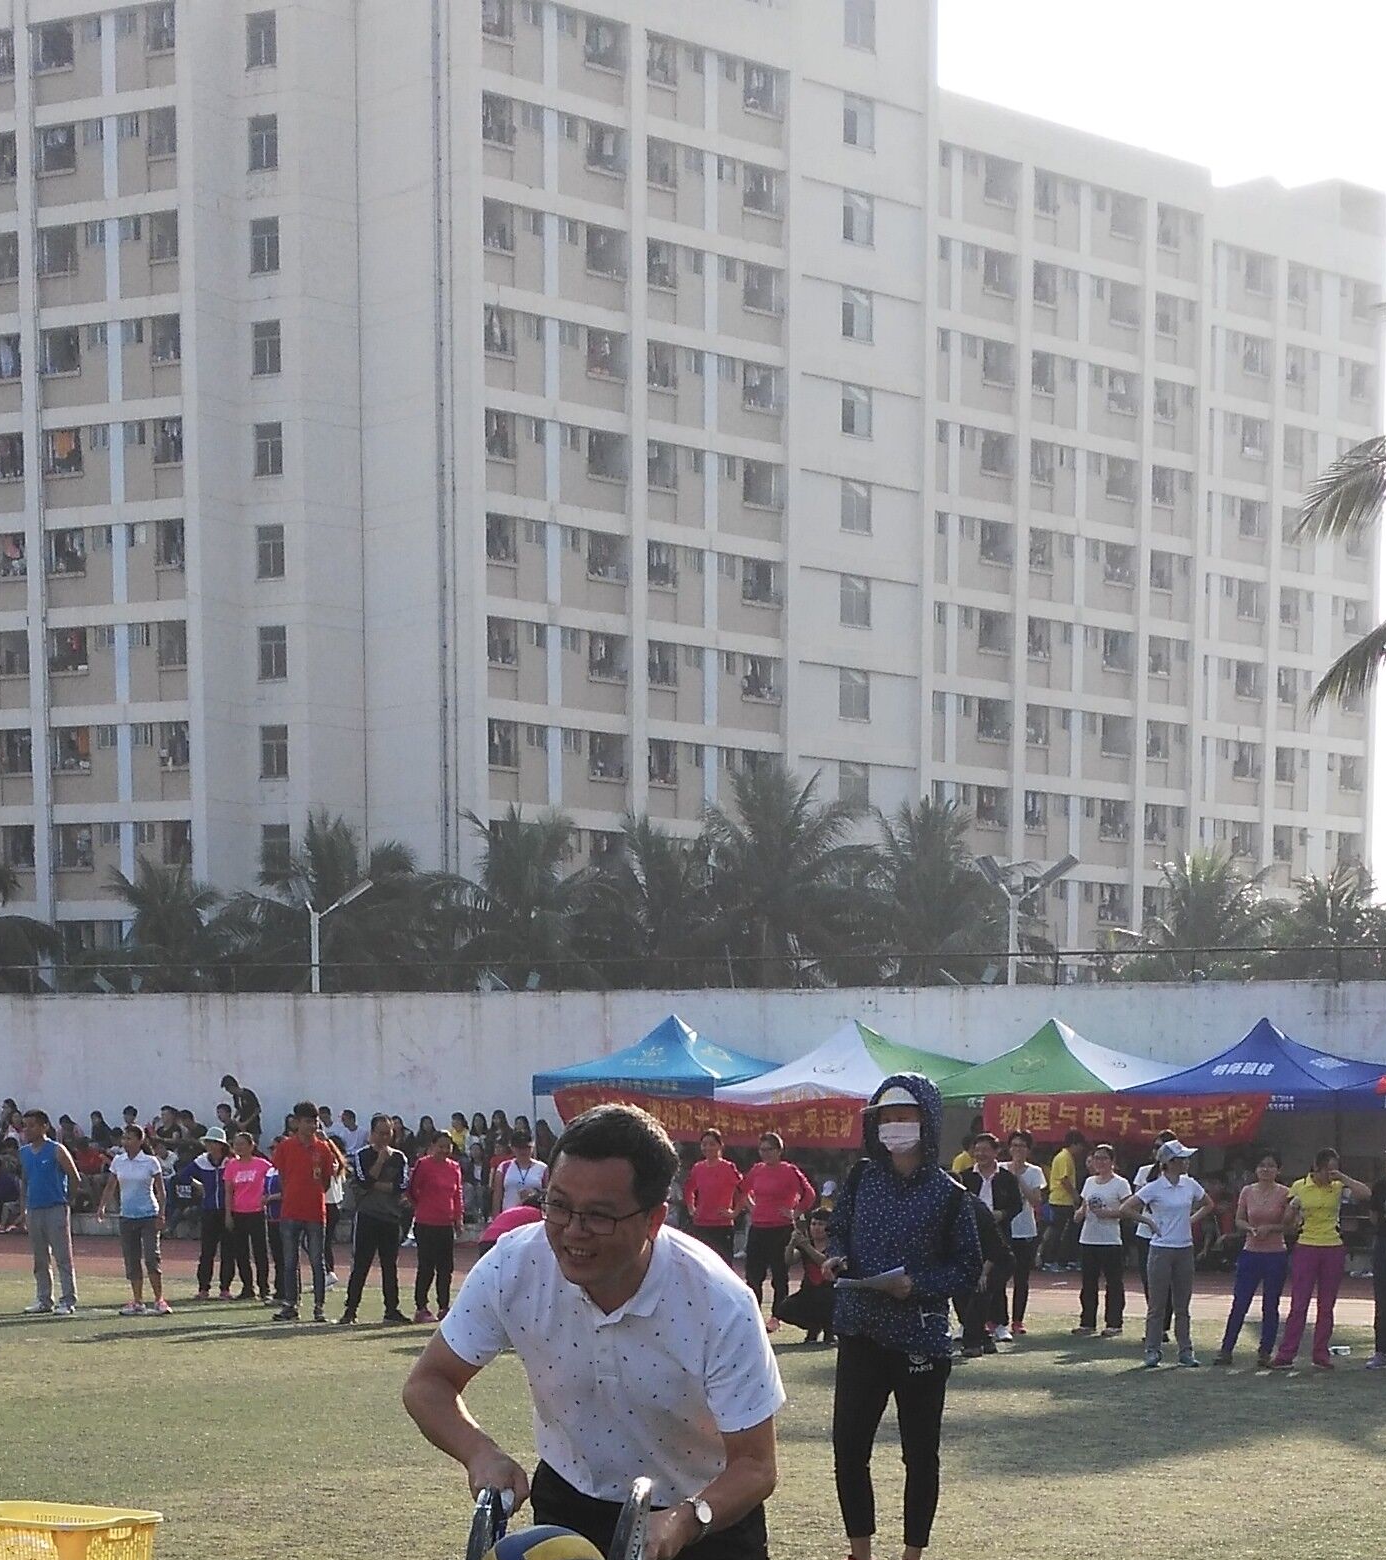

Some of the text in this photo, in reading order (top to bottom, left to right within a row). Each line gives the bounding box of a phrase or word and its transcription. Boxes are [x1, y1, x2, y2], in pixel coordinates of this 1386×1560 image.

[999, 1101, 1254, 1136] 物理与电子工程学院
